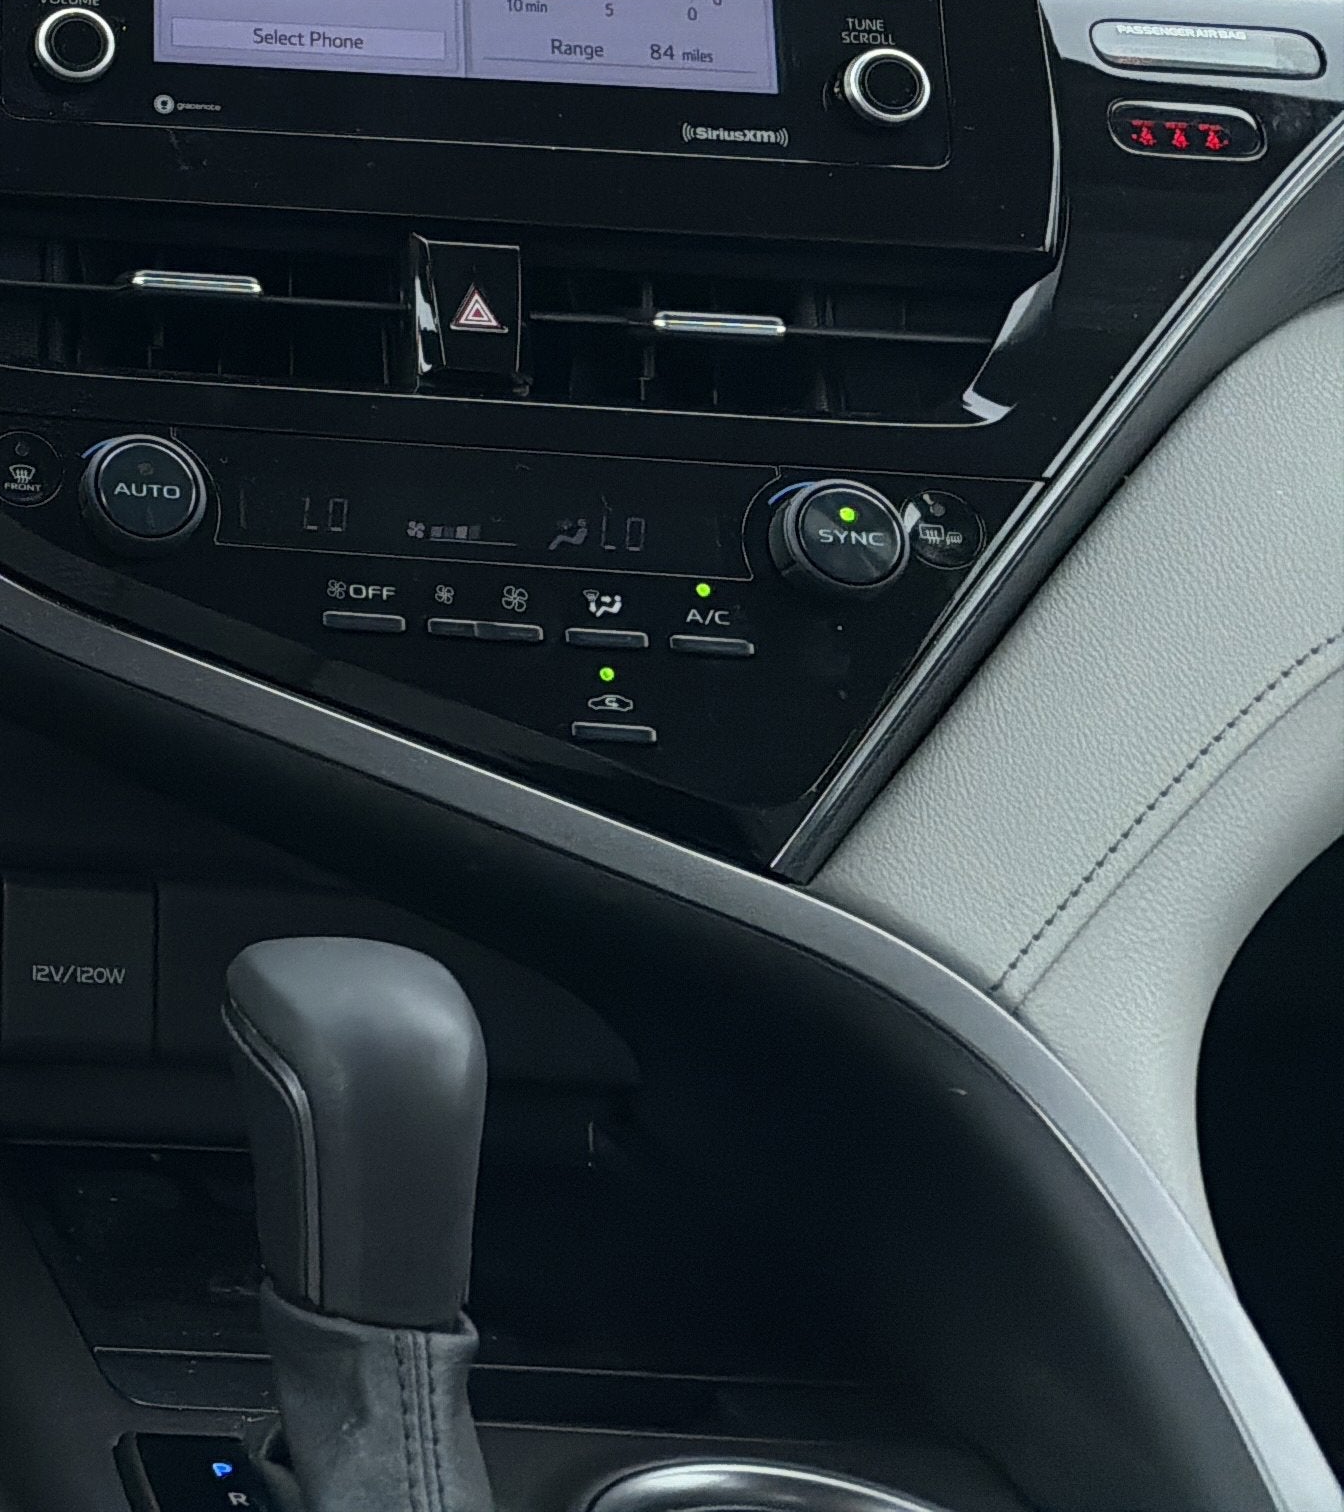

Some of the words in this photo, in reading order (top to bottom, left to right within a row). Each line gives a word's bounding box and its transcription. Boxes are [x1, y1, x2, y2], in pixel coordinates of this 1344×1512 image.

[525, 0, 548, 13] min
[605, 3, 614, 17] 5
[687, 6, 698, 21] 0
[846, 18, 885, 31] TUNE
[252, 27, 305, 46] Select
[309, 31, 364, 50] Phone
[841, 31, 896, 46] SCROLL
[551, 38, 605, 60] Range
[650, 43, 675, 60] 84
[682, 48, 714, 63] miles
[3, 482, 42, 492] FRONT
[113, 482, 181, 500] AUTO
[818, 528, 886, 548] SYNC
[348, 584, 396, 600] OFF
[685, 607, 731, 627] A/C
[31, 964, 126, 985] 12V/120W
[212, 1462, 232, 1477] P
[227, 1491, 250, 1506] R
